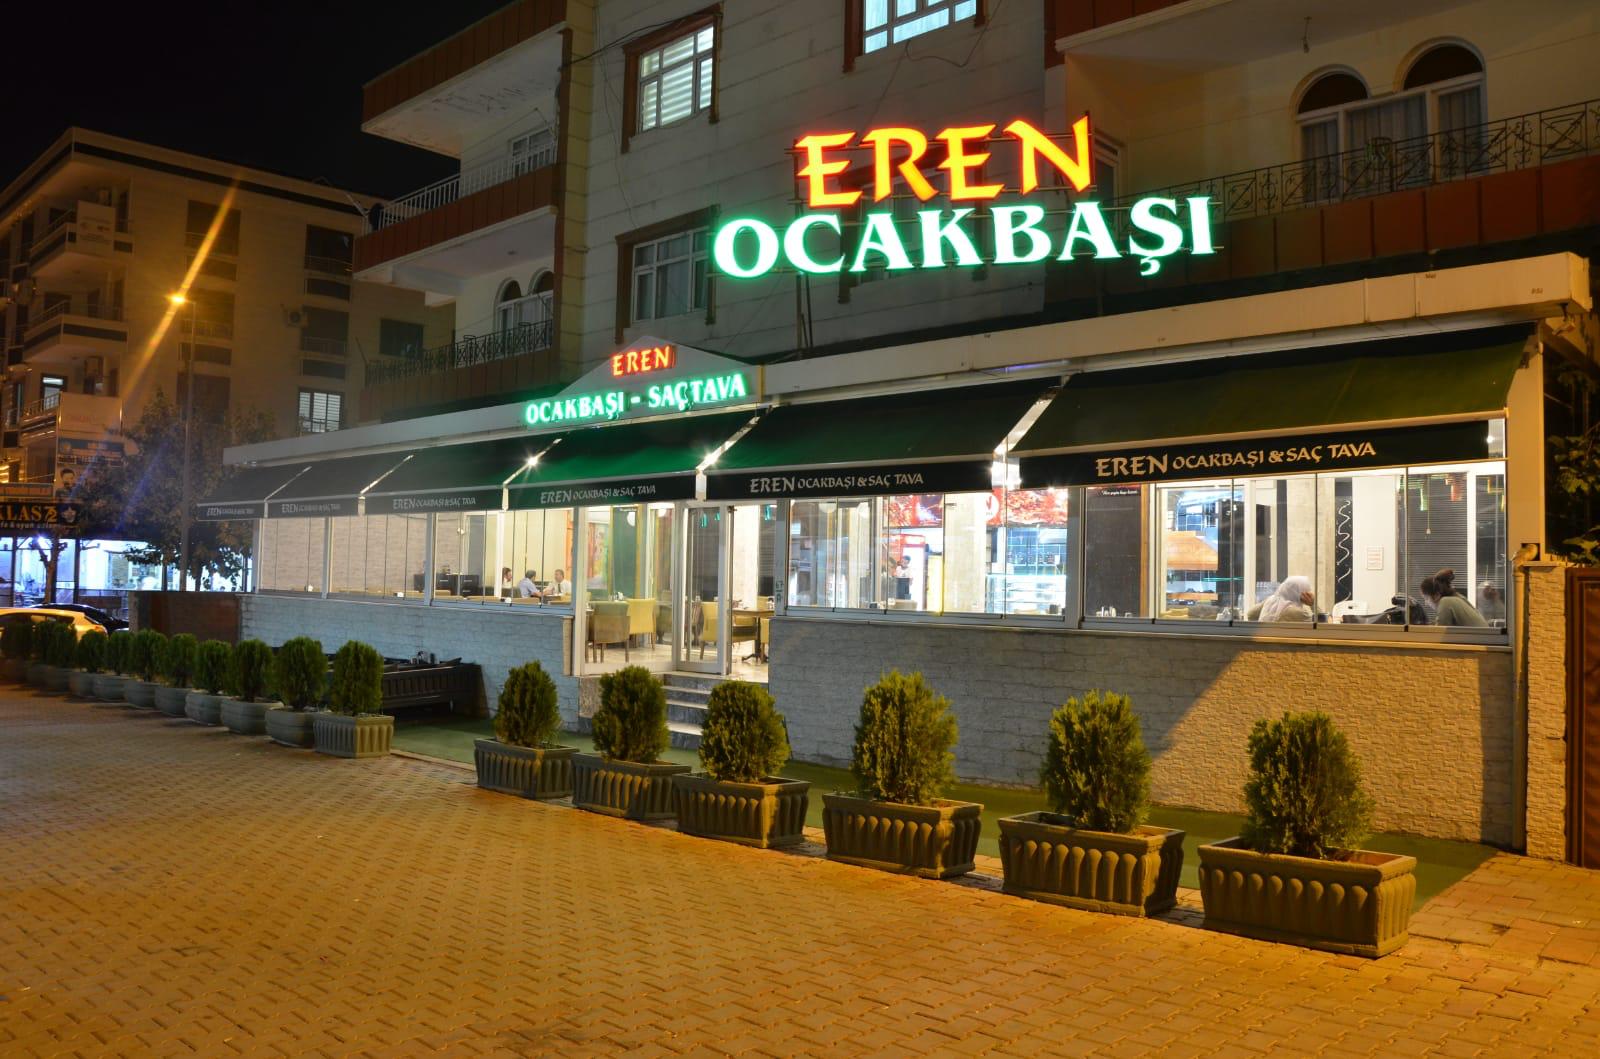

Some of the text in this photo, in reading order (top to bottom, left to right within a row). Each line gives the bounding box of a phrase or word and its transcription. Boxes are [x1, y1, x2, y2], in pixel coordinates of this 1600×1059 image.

[796, 114, 1092, 208] EREN
[713, 195, 1216, 277] OCAKBAŞI
[612, 345, 672, 377] EREN
[525, 391, 624, 424] OCAKBAŞI
[1095, 454, 1168, 477] EREN
[1172, 450, 1264, 469] OCAKBAŞI
[1327, 442, 1377, 458] TAVA
[540, 488, 572, 504] EREN
[637, 485, 656, 495] TAVA
[750, 476, 796, 493] EREN
[797, 476, 855, 490] OCAKBAŞI
[894, 473, 924, 485] TAVA
[393, 498, 416, 510] EREN
